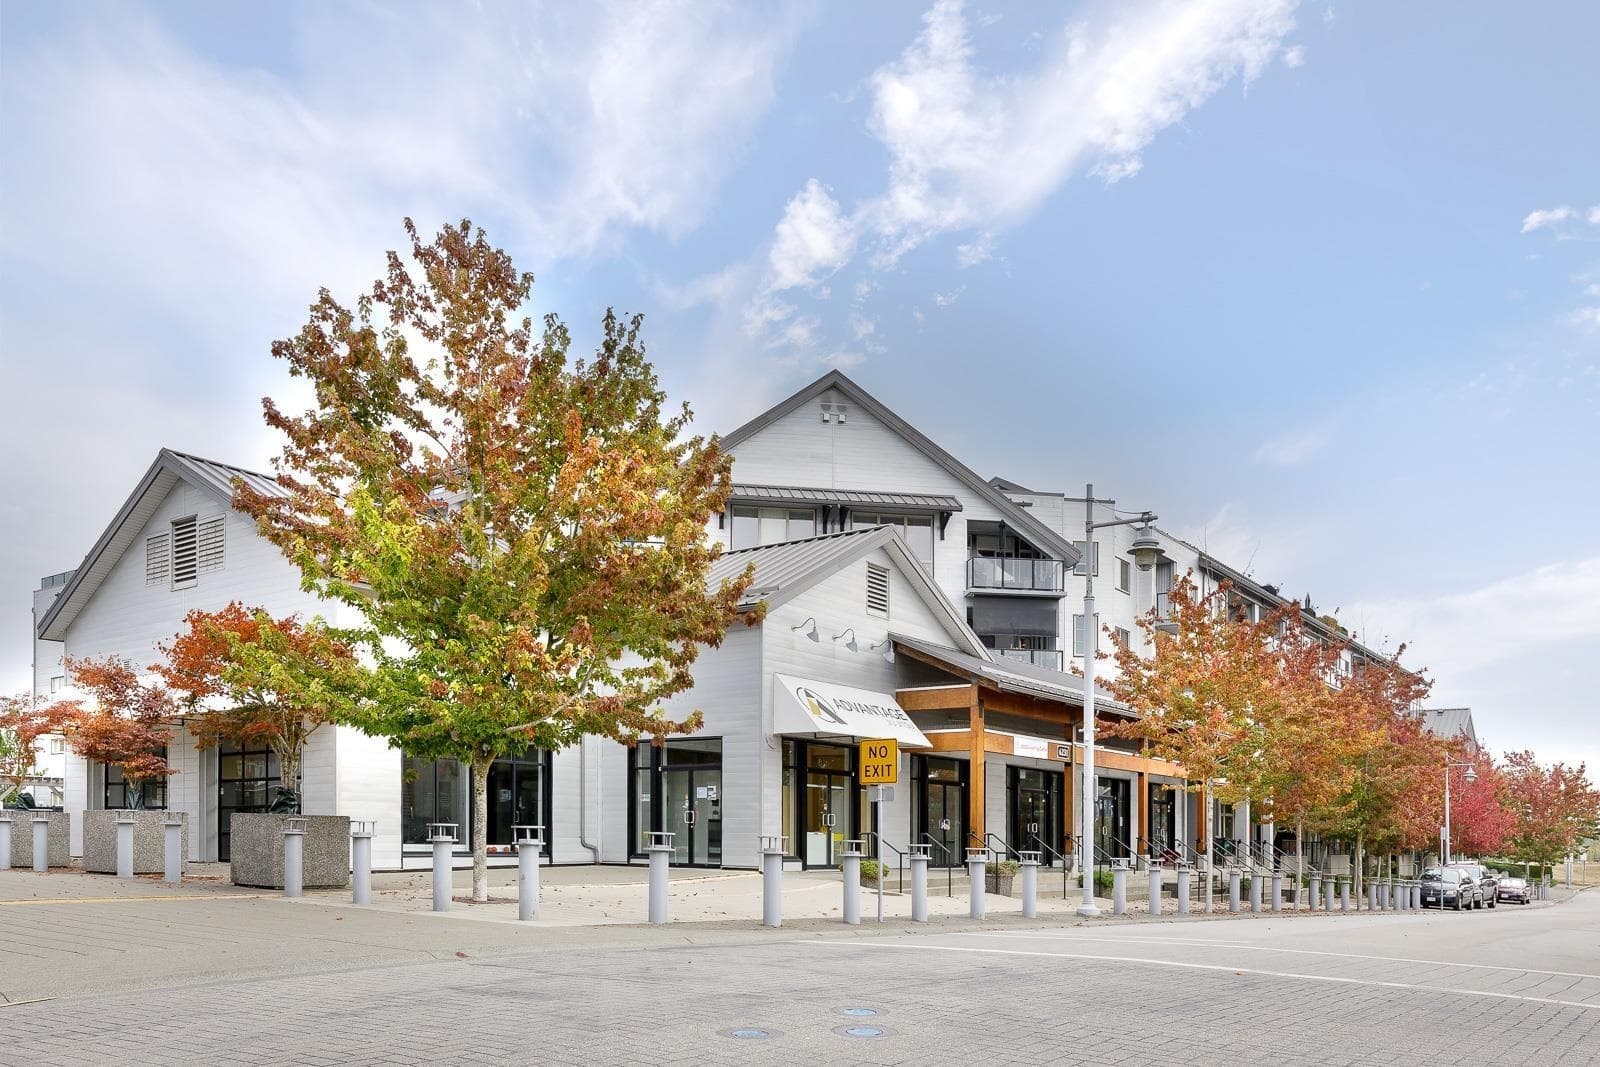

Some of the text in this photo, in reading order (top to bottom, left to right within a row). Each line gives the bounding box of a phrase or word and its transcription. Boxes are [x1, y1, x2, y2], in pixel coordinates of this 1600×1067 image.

[832, 698, 907, 720] ADVANTAGE
[868, 745, 888, 758] NO
[864, 764, 893, 778] EXIT
